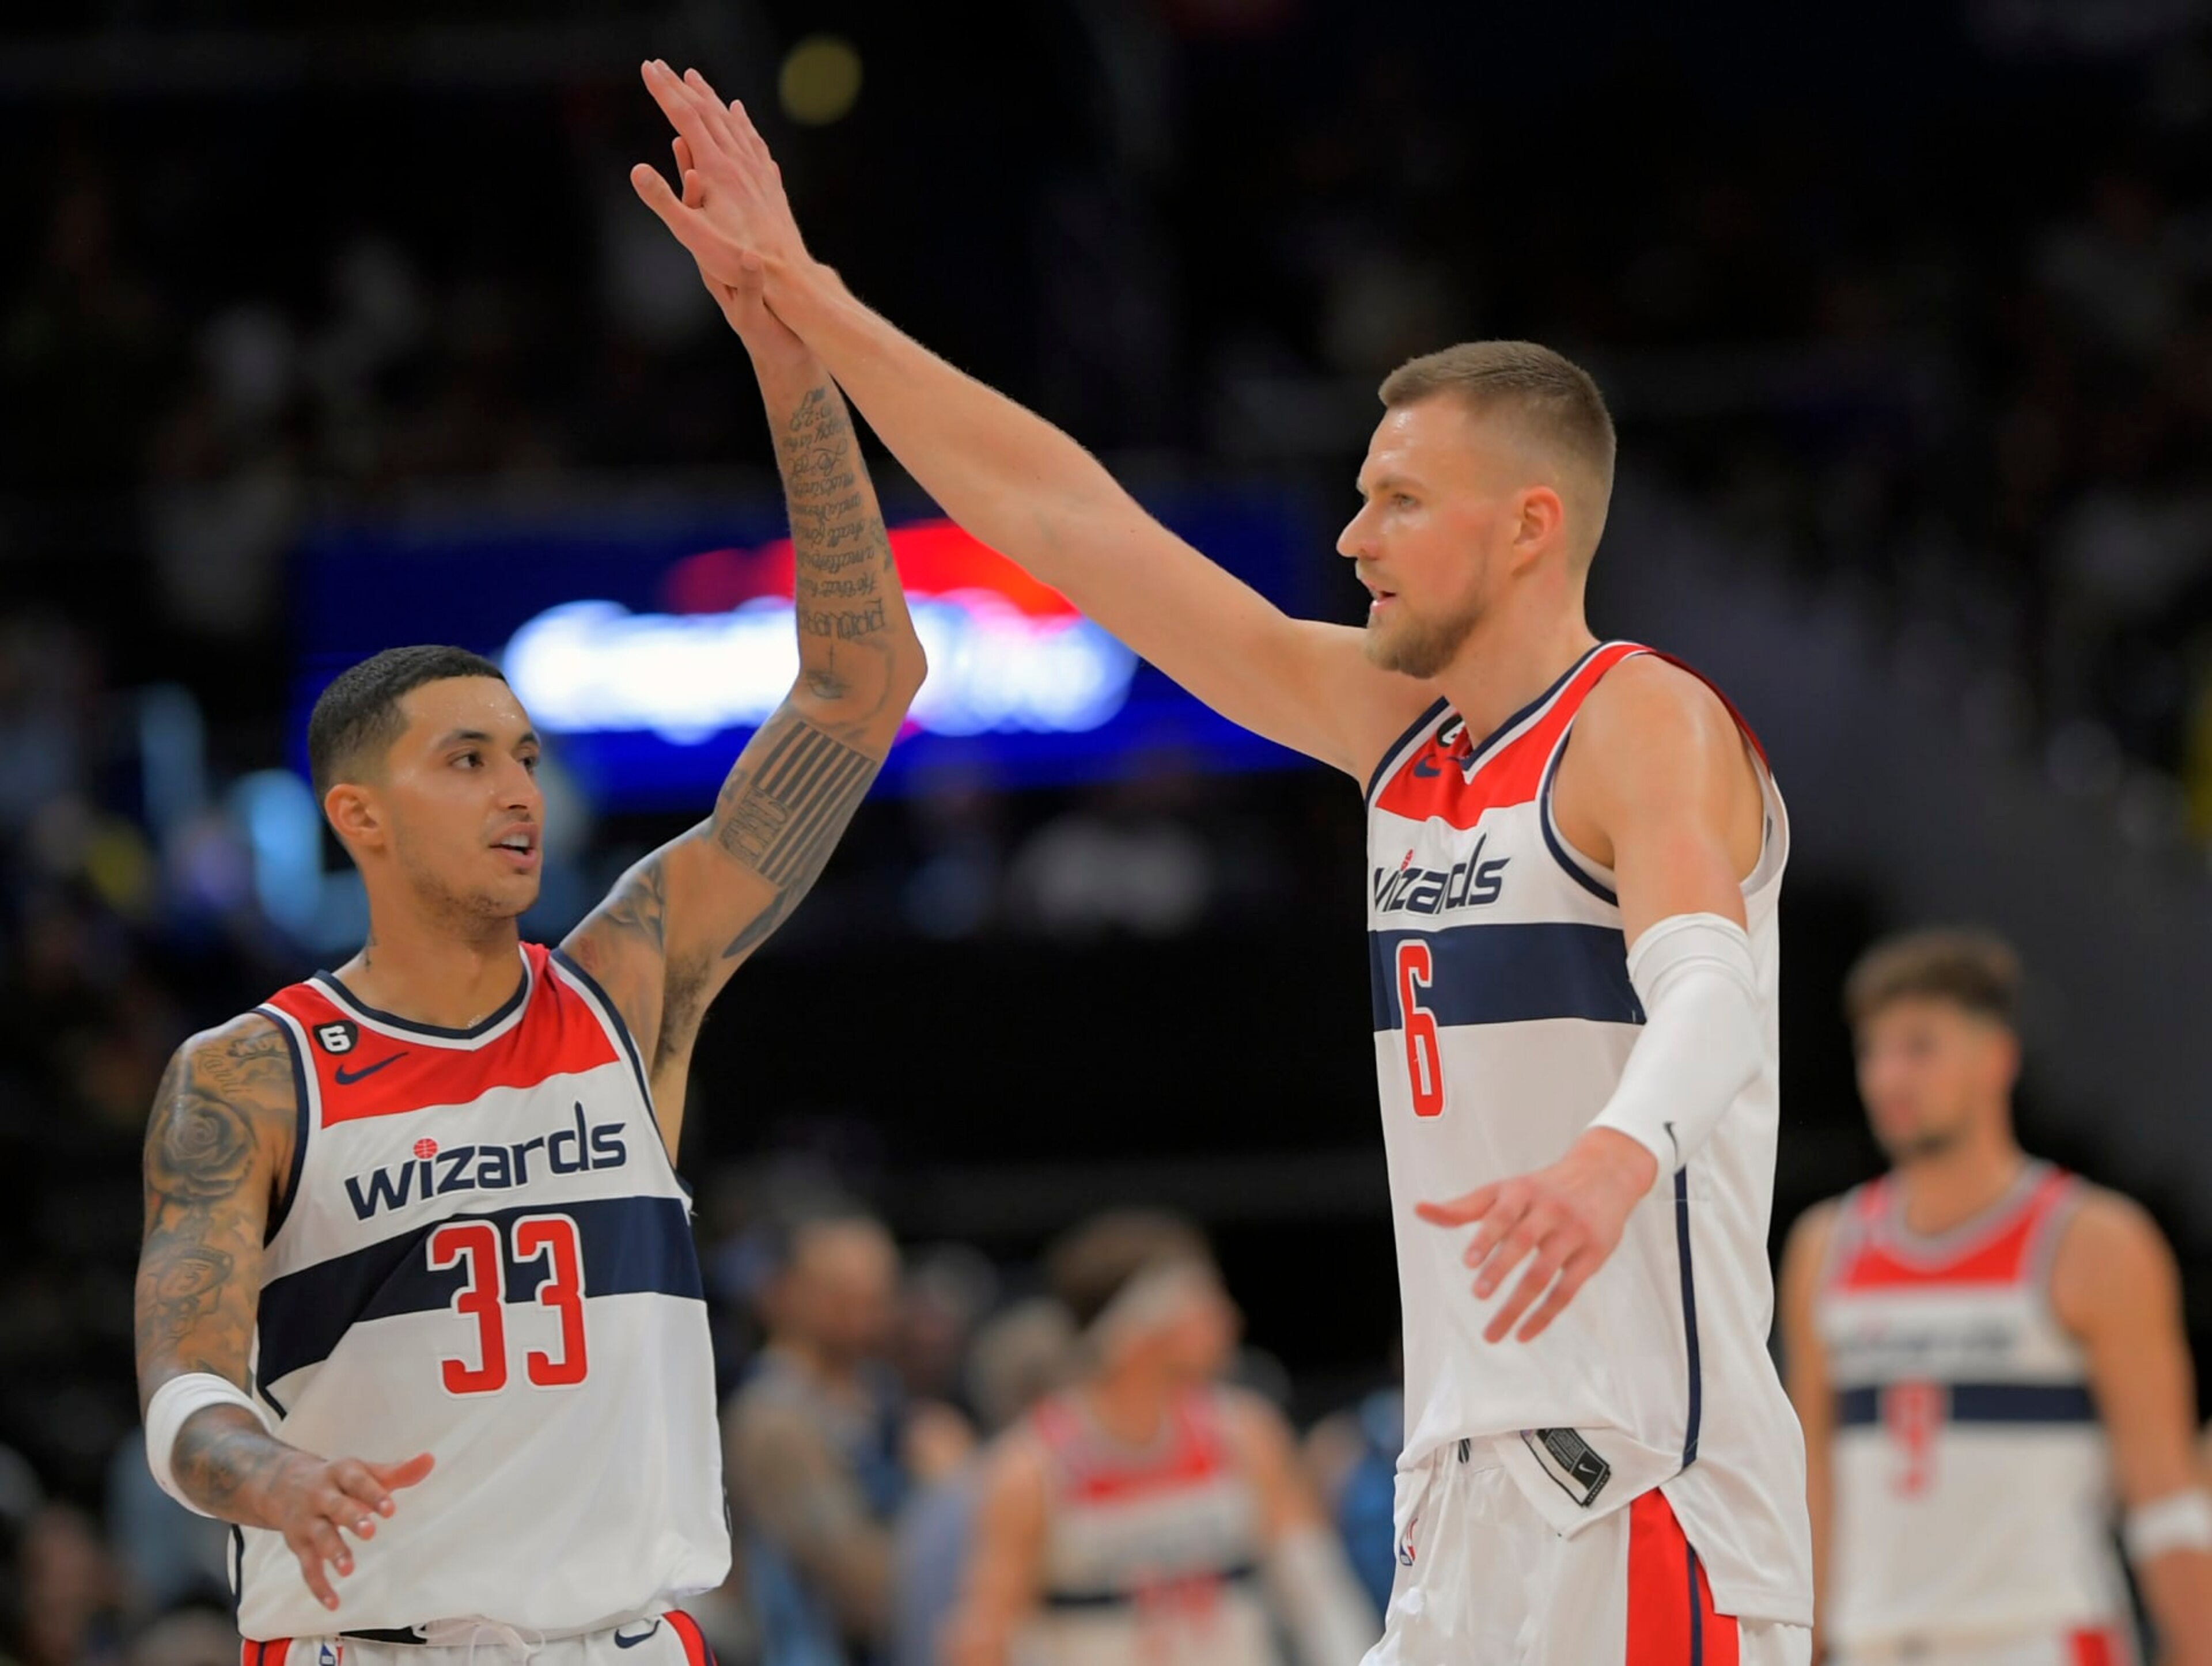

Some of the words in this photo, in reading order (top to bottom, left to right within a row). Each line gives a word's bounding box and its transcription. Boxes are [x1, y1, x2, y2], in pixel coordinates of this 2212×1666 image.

[317, 1025, 351, 1052] 6
[1396, 939, 1444, 1118] 6
[345, 1101, 626, 1221] wizards
[429, 1216, 589, 1396] 33
